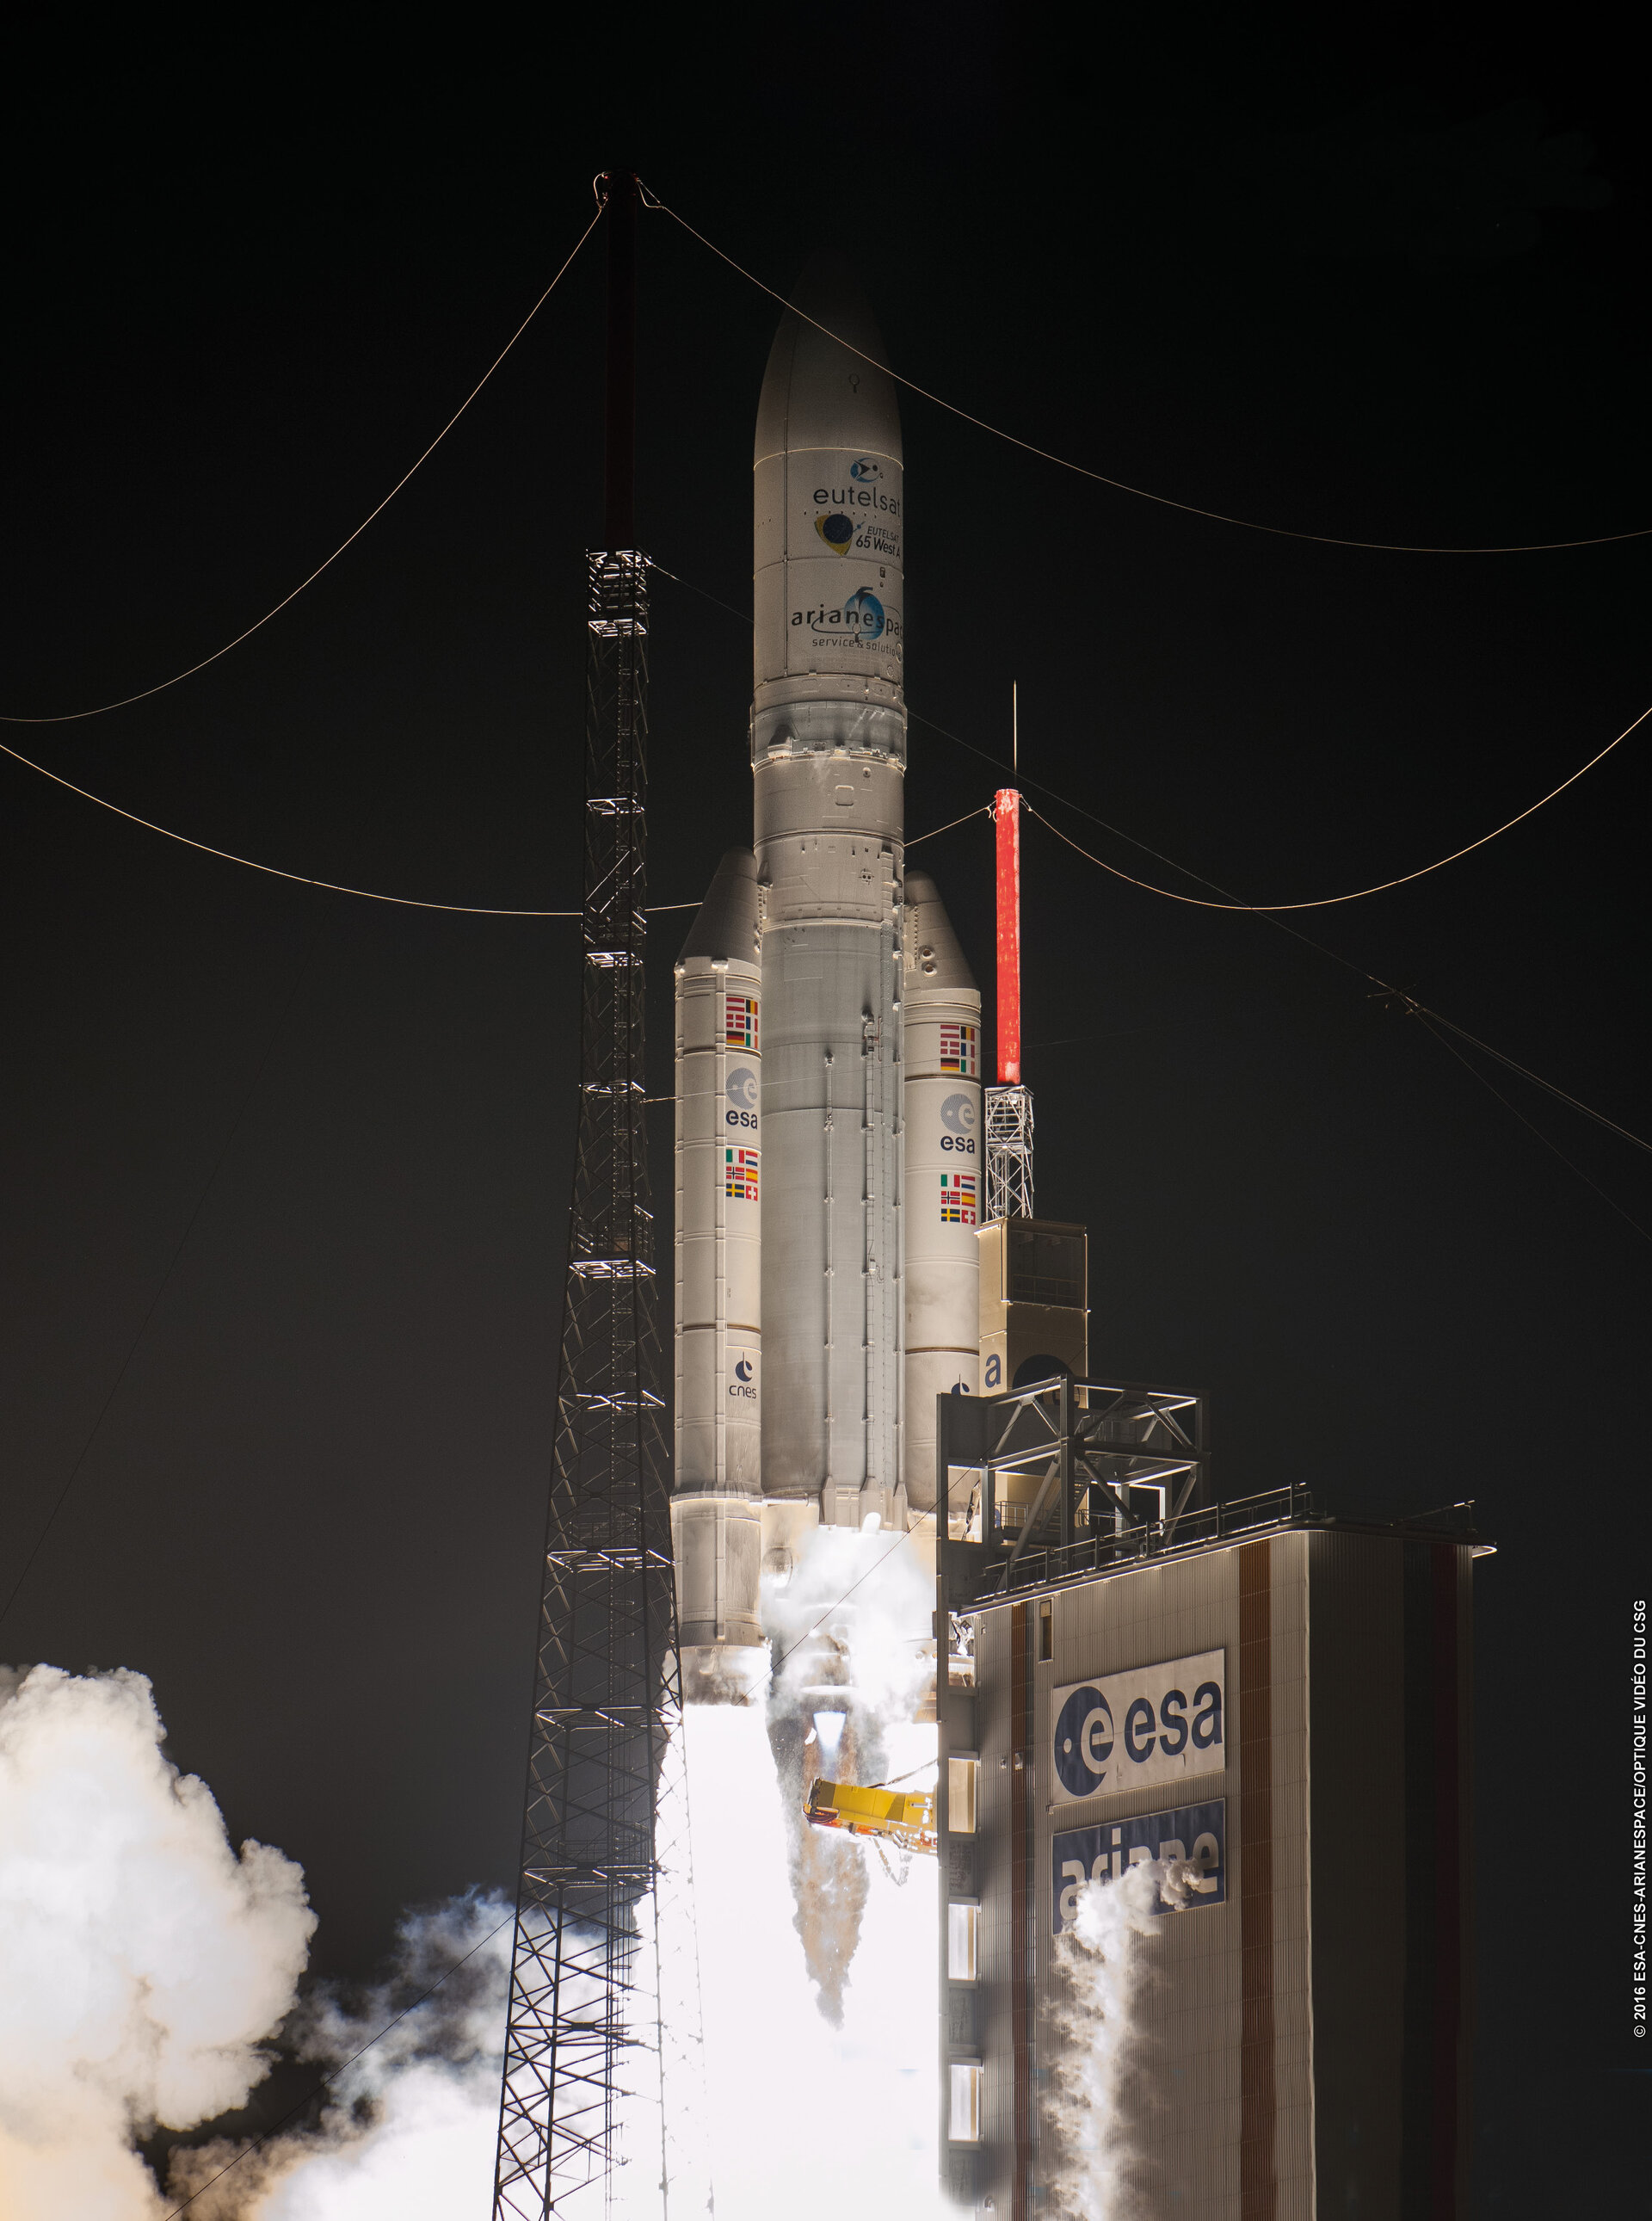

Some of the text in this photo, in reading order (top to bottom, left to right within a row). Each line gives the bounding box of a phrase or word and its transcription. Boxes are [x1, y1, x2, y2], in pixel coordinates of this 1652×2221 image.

[813, 486, 901, 517] eutelsat
[856, 534, 872, 549] 65
[873, 537, 896, 556] West
[867, 526, 899, 543] EUTELSAT
[812, 636, 855, 648] service
[866, 641, 901, 659] solutio
[725, 1110, 758, 1130] esa
[940, 1135, 976, 1154] esa
[729, 1385, 757, 1399] cnes
[1125, 1681, 1223, 1763] esa
